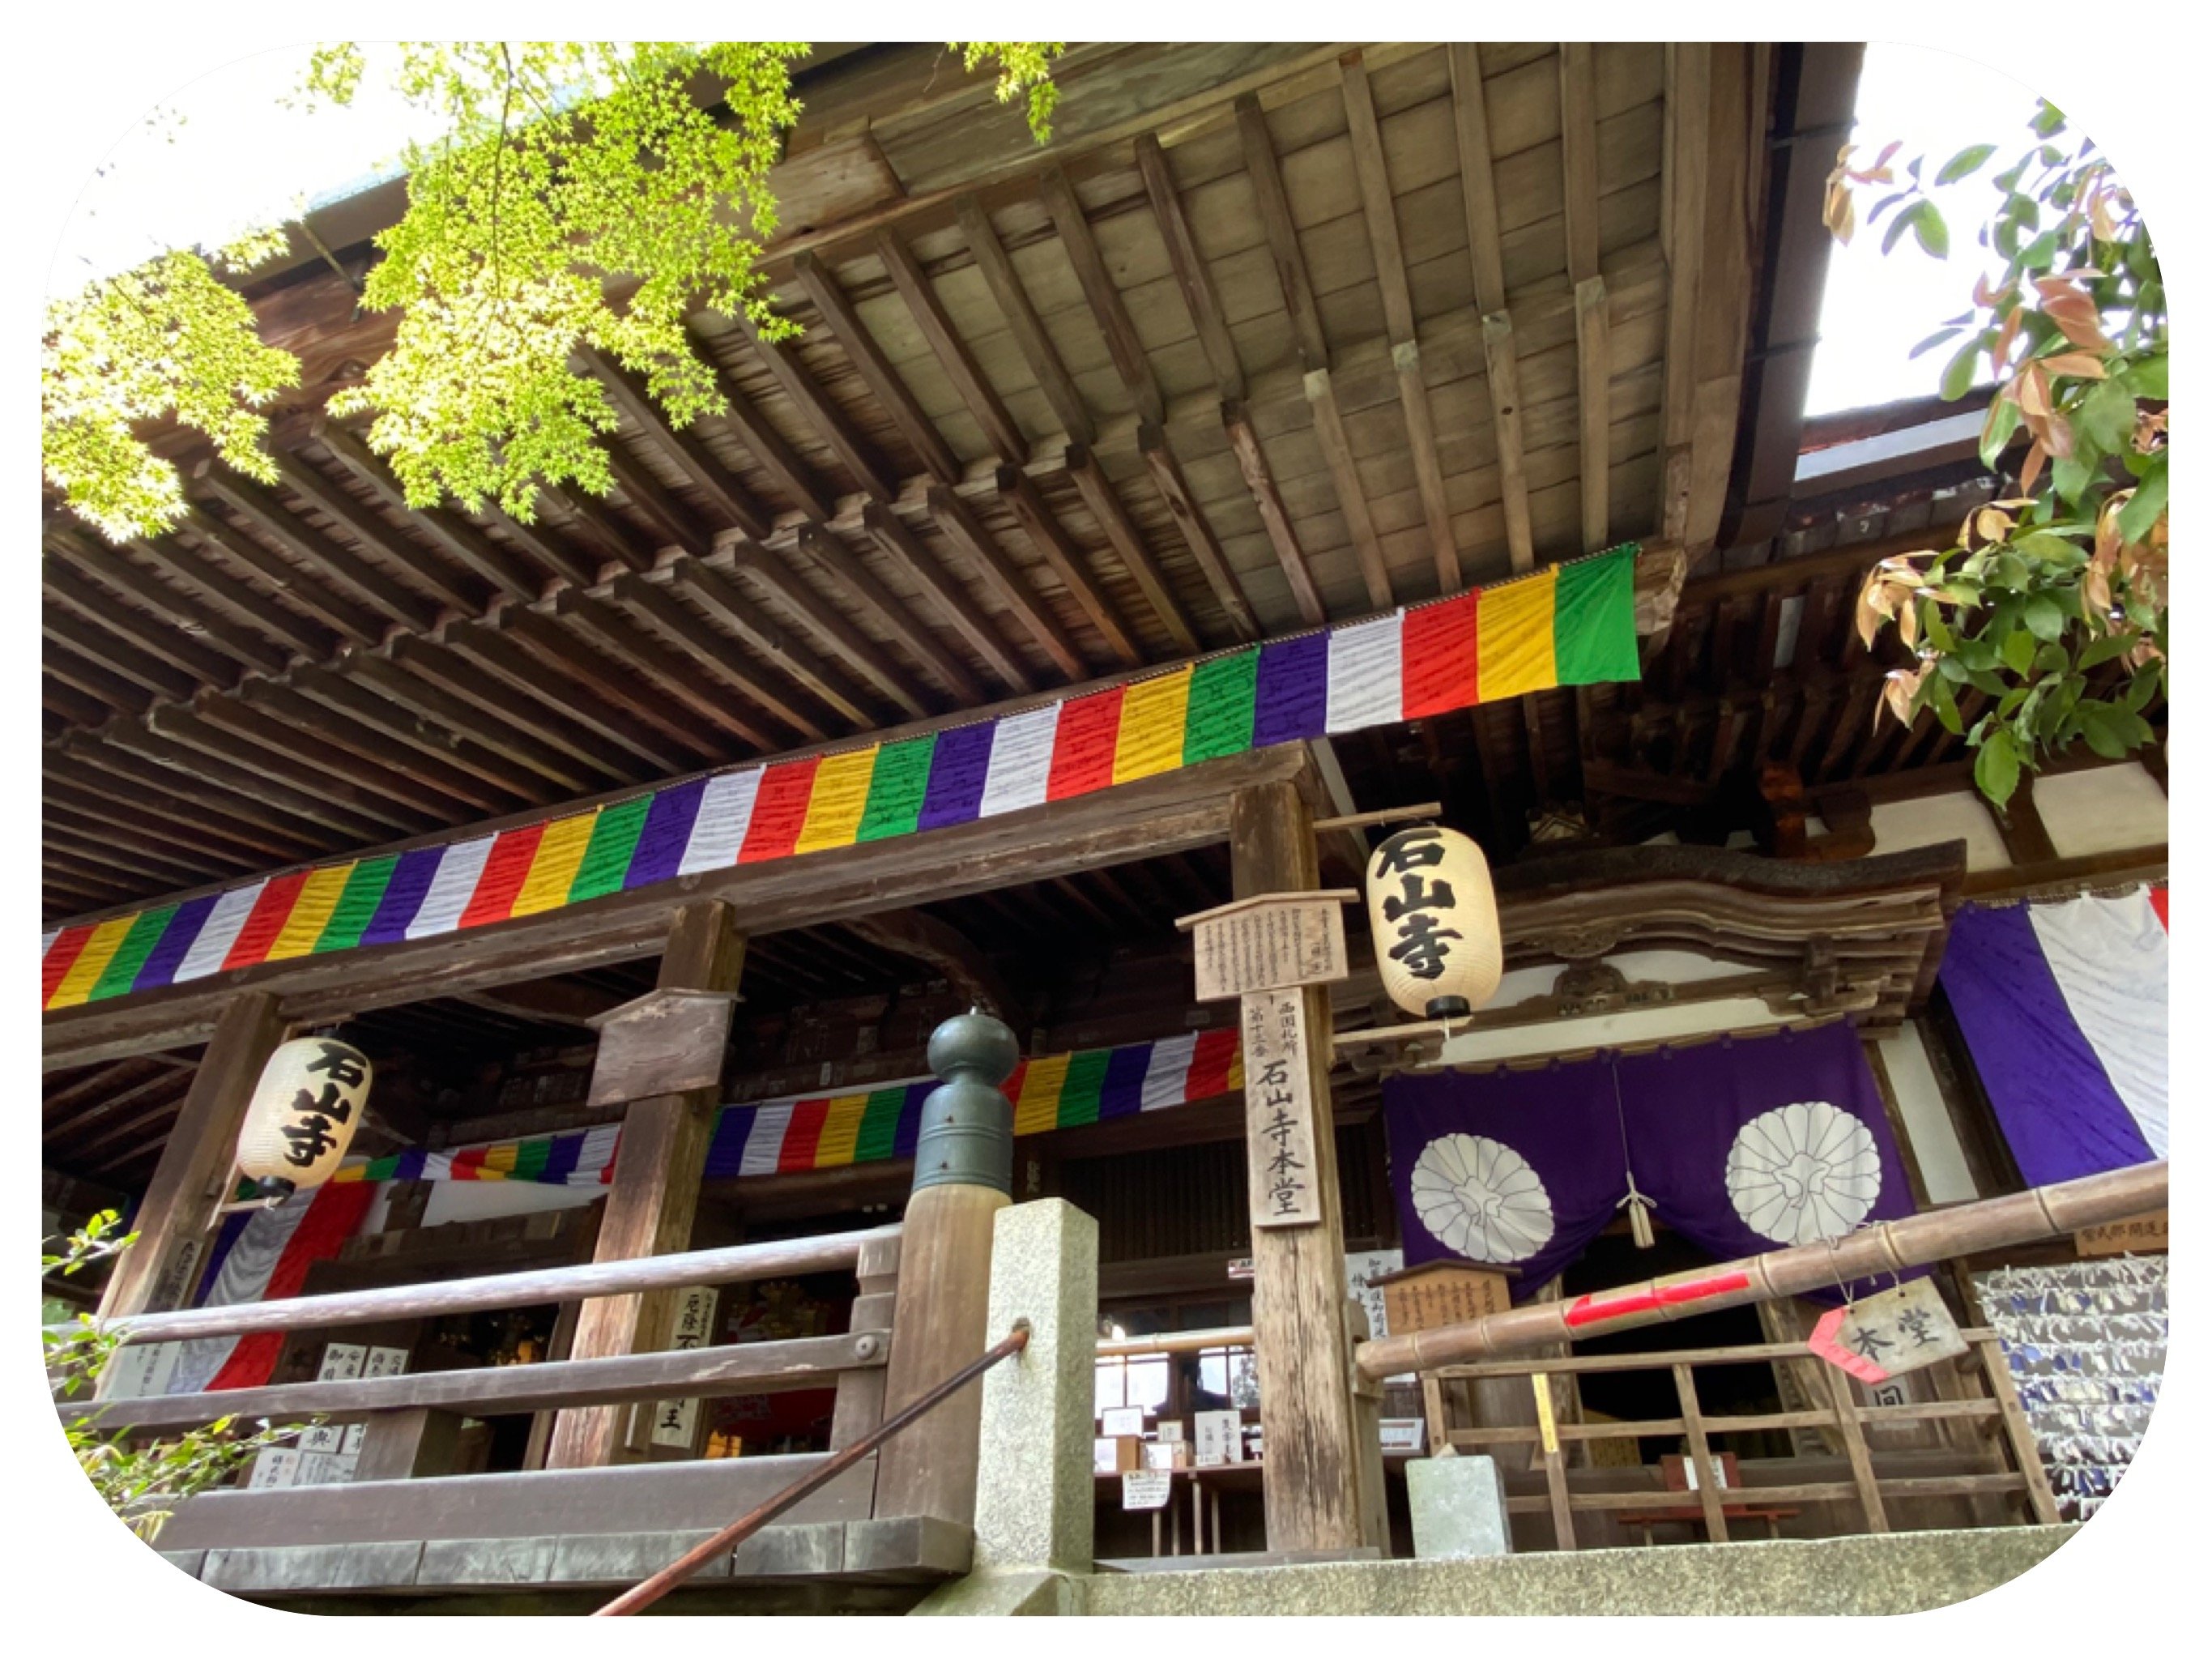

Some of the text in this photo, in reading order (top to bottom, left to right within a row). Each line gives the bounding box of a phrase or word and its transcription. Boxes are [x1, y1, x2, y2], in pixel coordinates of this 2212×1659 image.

[1375, 830, 1464, 979] 石山寺
[280, 1042, 367, 1167] 石山寺
[1255, 1059, 1306, 1216] 石山寺本堂
[1851, 1306, 1941, 1363] 本堂
